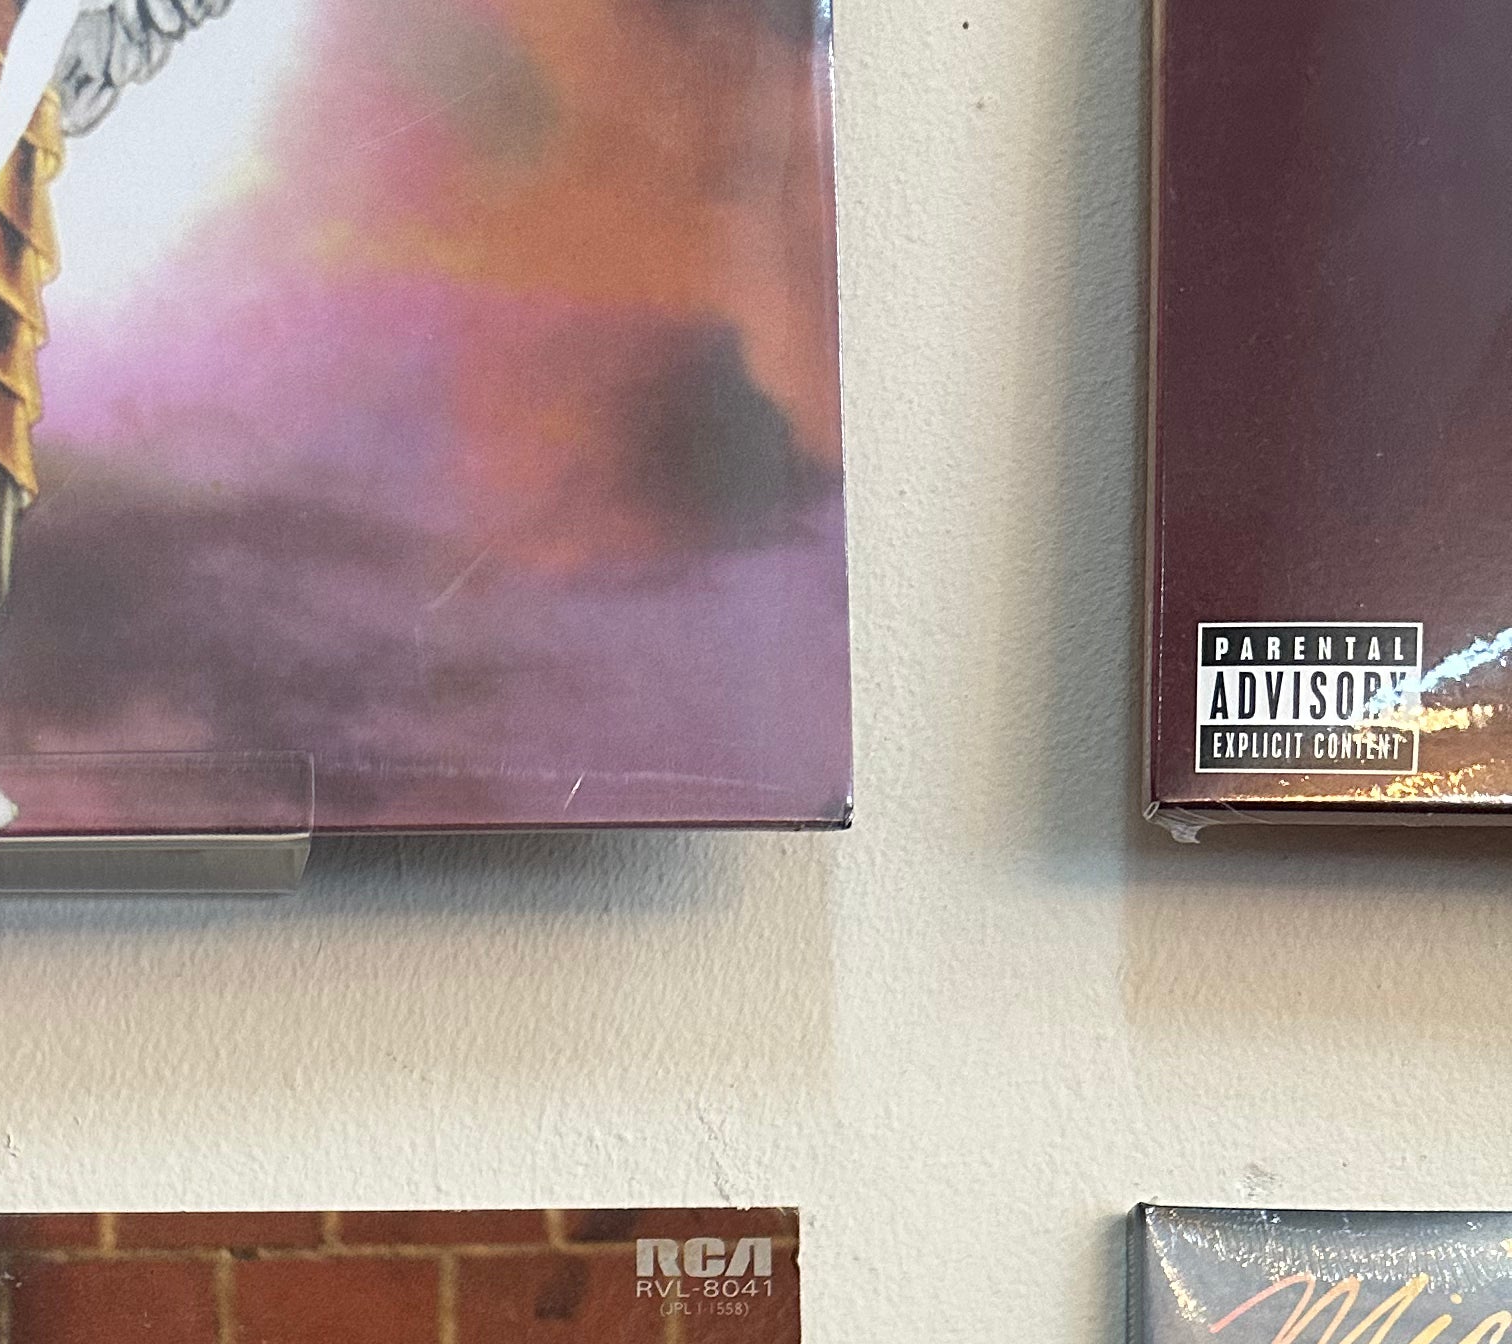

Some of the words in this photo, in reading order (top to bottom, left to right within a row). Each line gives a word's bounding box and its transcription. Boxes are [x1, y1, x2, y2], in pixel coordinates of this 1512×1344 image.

[1215, 637, 1404, 660] PARENTAL
[1213, 732, 1303, 759] EXPLICIT
[1314, 732, 1401, 760] CONTENT
[636, 1237, 772, 1278] RCA
[636, 1279, 772, 1298] RVL-8041
